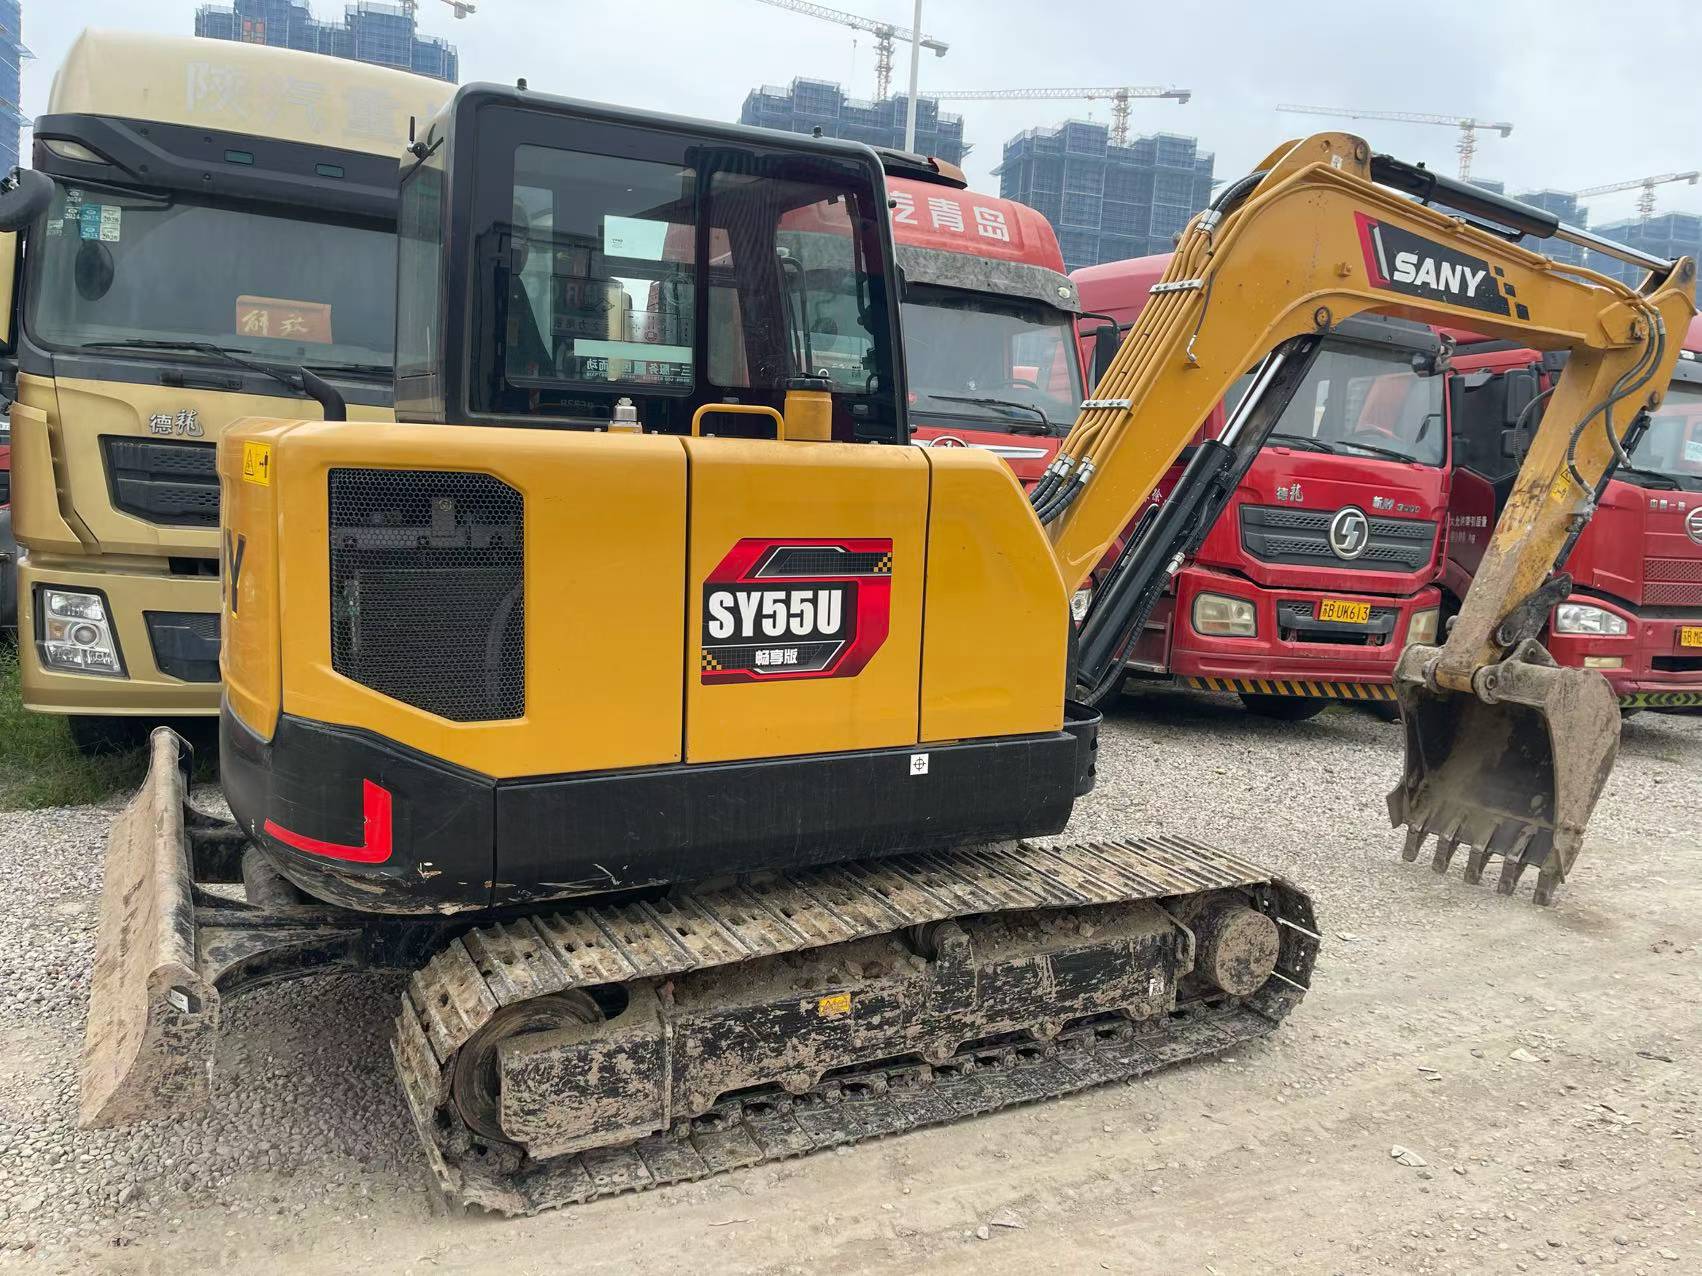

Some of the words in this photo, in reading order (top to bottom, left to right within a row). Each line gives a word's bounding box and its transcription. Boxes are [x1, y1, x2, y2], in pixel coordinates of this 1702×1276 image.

[1393, 251, 1487, 298] SANY
[708, 590, 842, 639] SY55U
[755, 648, 798, 666] 畅享版
